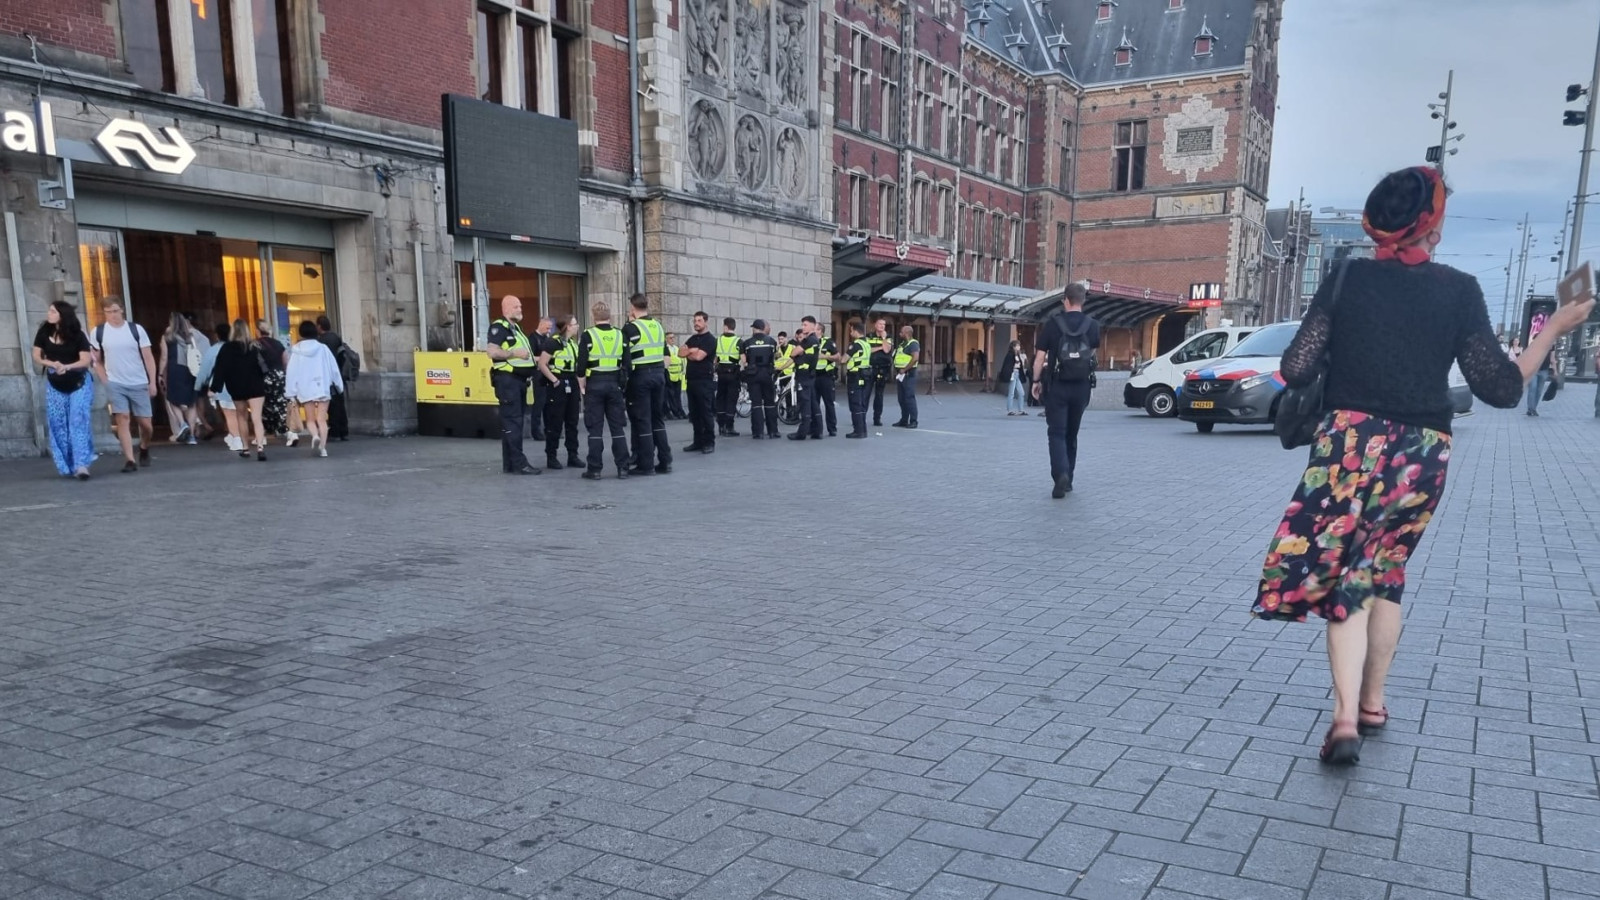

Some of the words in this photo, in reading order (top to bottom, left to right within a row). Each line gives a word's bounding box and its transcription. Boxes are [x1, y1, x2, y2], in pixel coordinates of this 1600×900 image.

[3, 101, 56, 156] al
[1192, 284, 1205, 299] M
[1210, 283, 1220, 299] M
[427, 370, 450, 378] Boels
